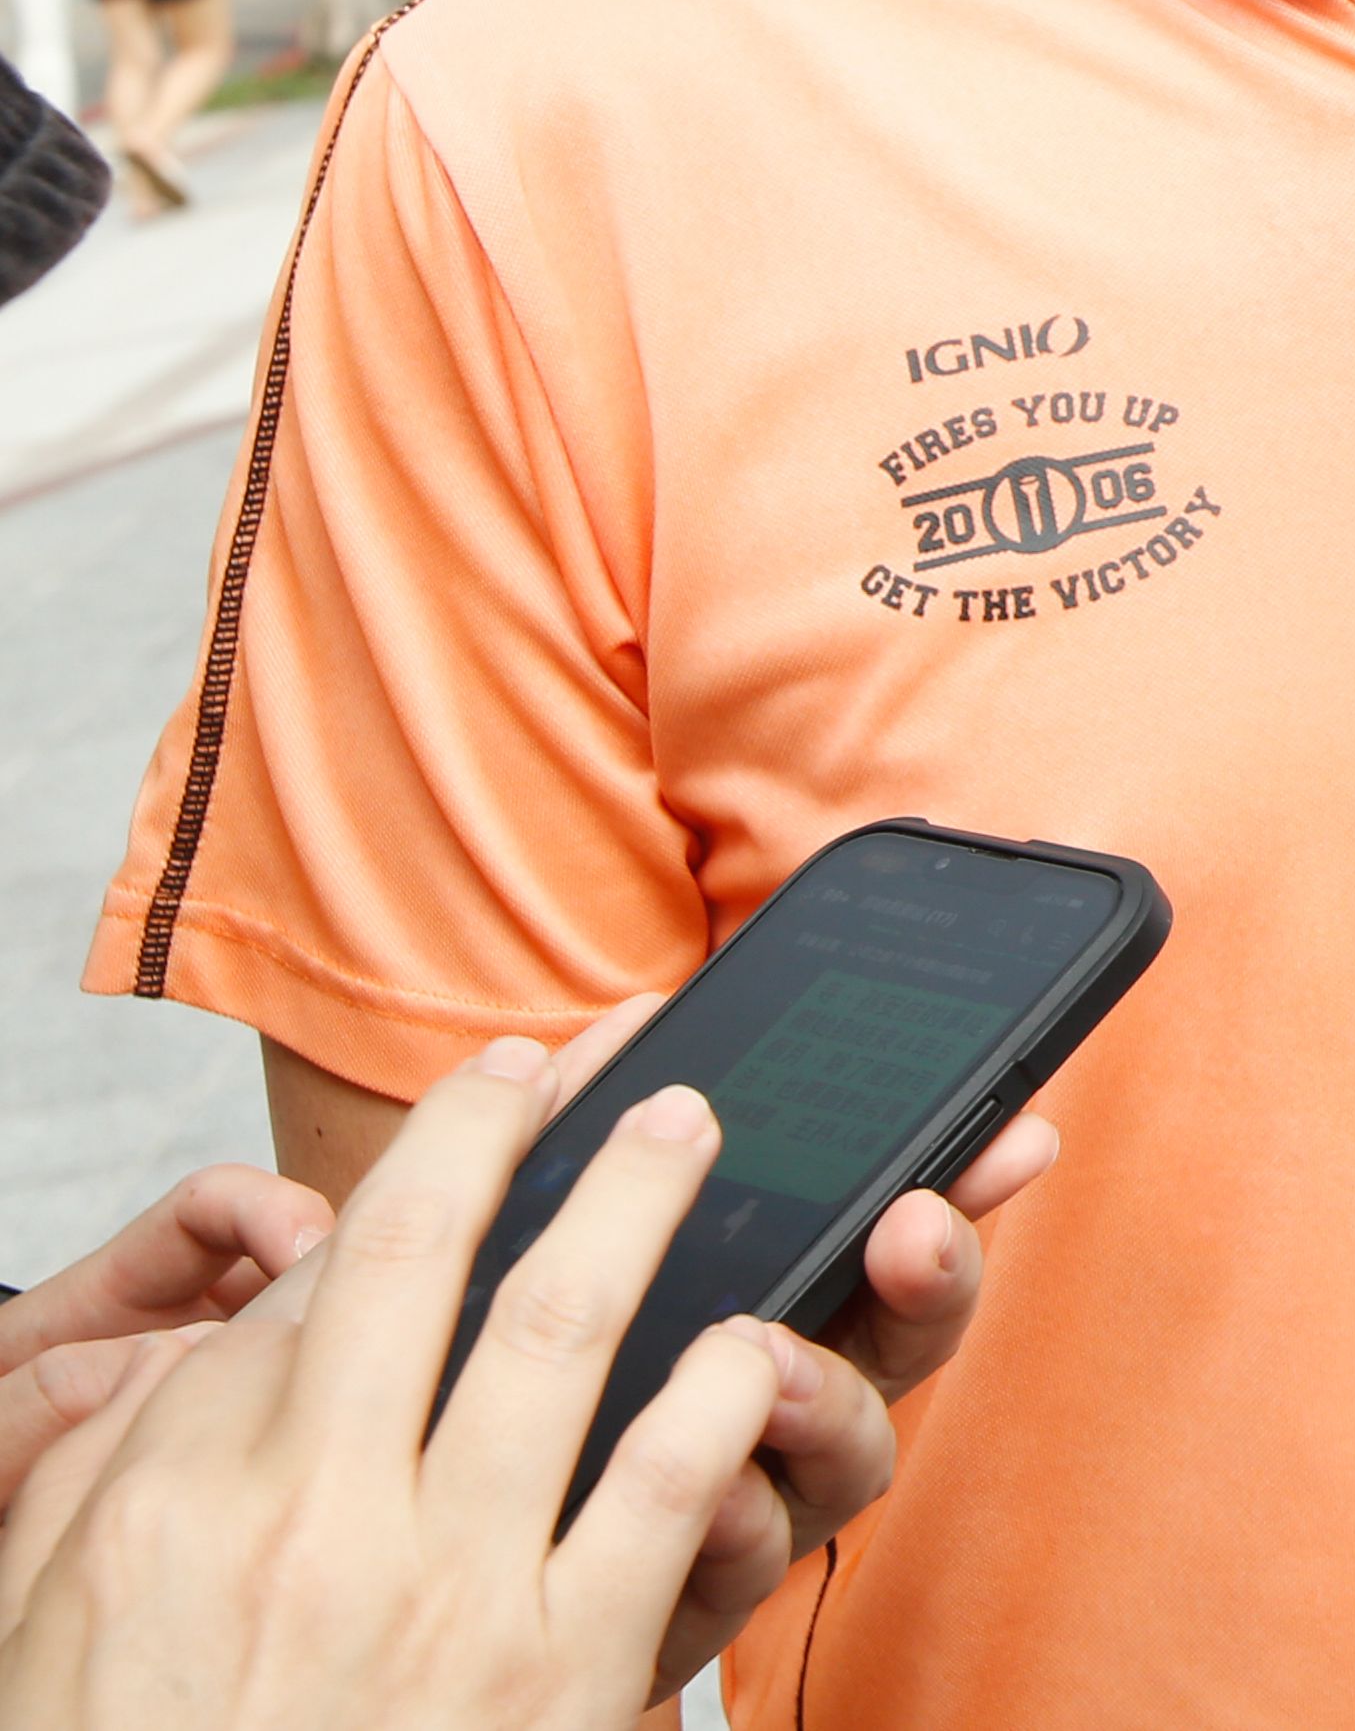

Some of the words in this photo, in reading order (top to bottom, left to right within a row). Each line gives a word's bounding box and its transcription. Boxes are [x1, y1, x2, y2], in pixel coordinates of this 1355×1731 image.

[905, 314, 1091, 384] IGNIO
[879, 407, 997, 486] FIRES
[1011, 391, 1106, 427] YOU
[1123, 395, 1180, 433] UP
[860, 564, 939, 618] GET
[953, 585, 1037, 622] THE
[1050, 484, 1223, 610] VICTORY
